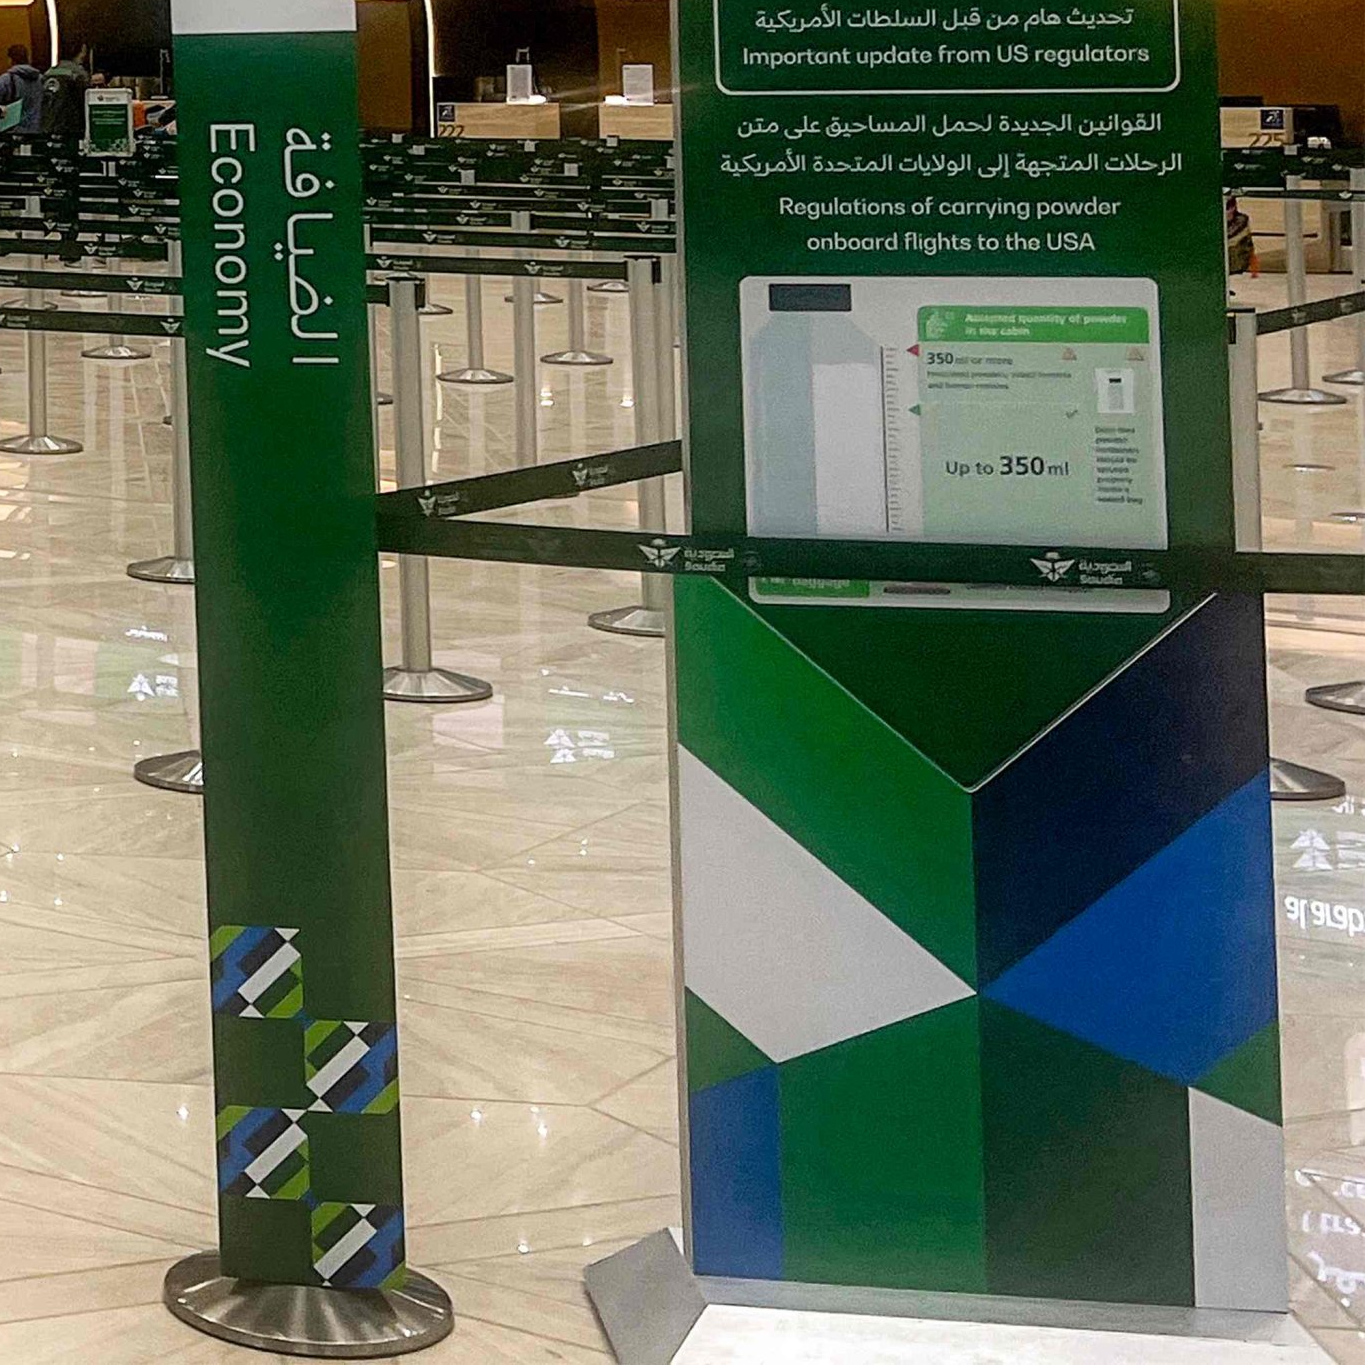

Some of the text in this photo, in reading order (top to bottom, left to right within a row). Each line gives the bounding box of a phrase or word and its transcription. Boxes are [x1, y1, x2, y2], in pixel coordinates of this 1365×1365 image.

[755, 3, 1133, 32] تحديث هام من قبل السلطات الأمريكية
[742, 45, 1149, 67] Important update from US regulators
[737, 113, 1162, 139] القوانين الجديدة لحمل المساحيق على متن
[720, 148, 1182, 178] الرحلات المتجهة إلى الولايات المتحدة الأمريكية
[778, 196, 1121, 220] Regulations of carrying powder
[206, 123, 256, 368] Economy
[273, 125, 340, 365] الضيافة
[807, 232, 1095, 255] onboard flights to the USA
[927, 352, 954, 365] 350
[945, 455, 1069, 477] Up to 350 ml
